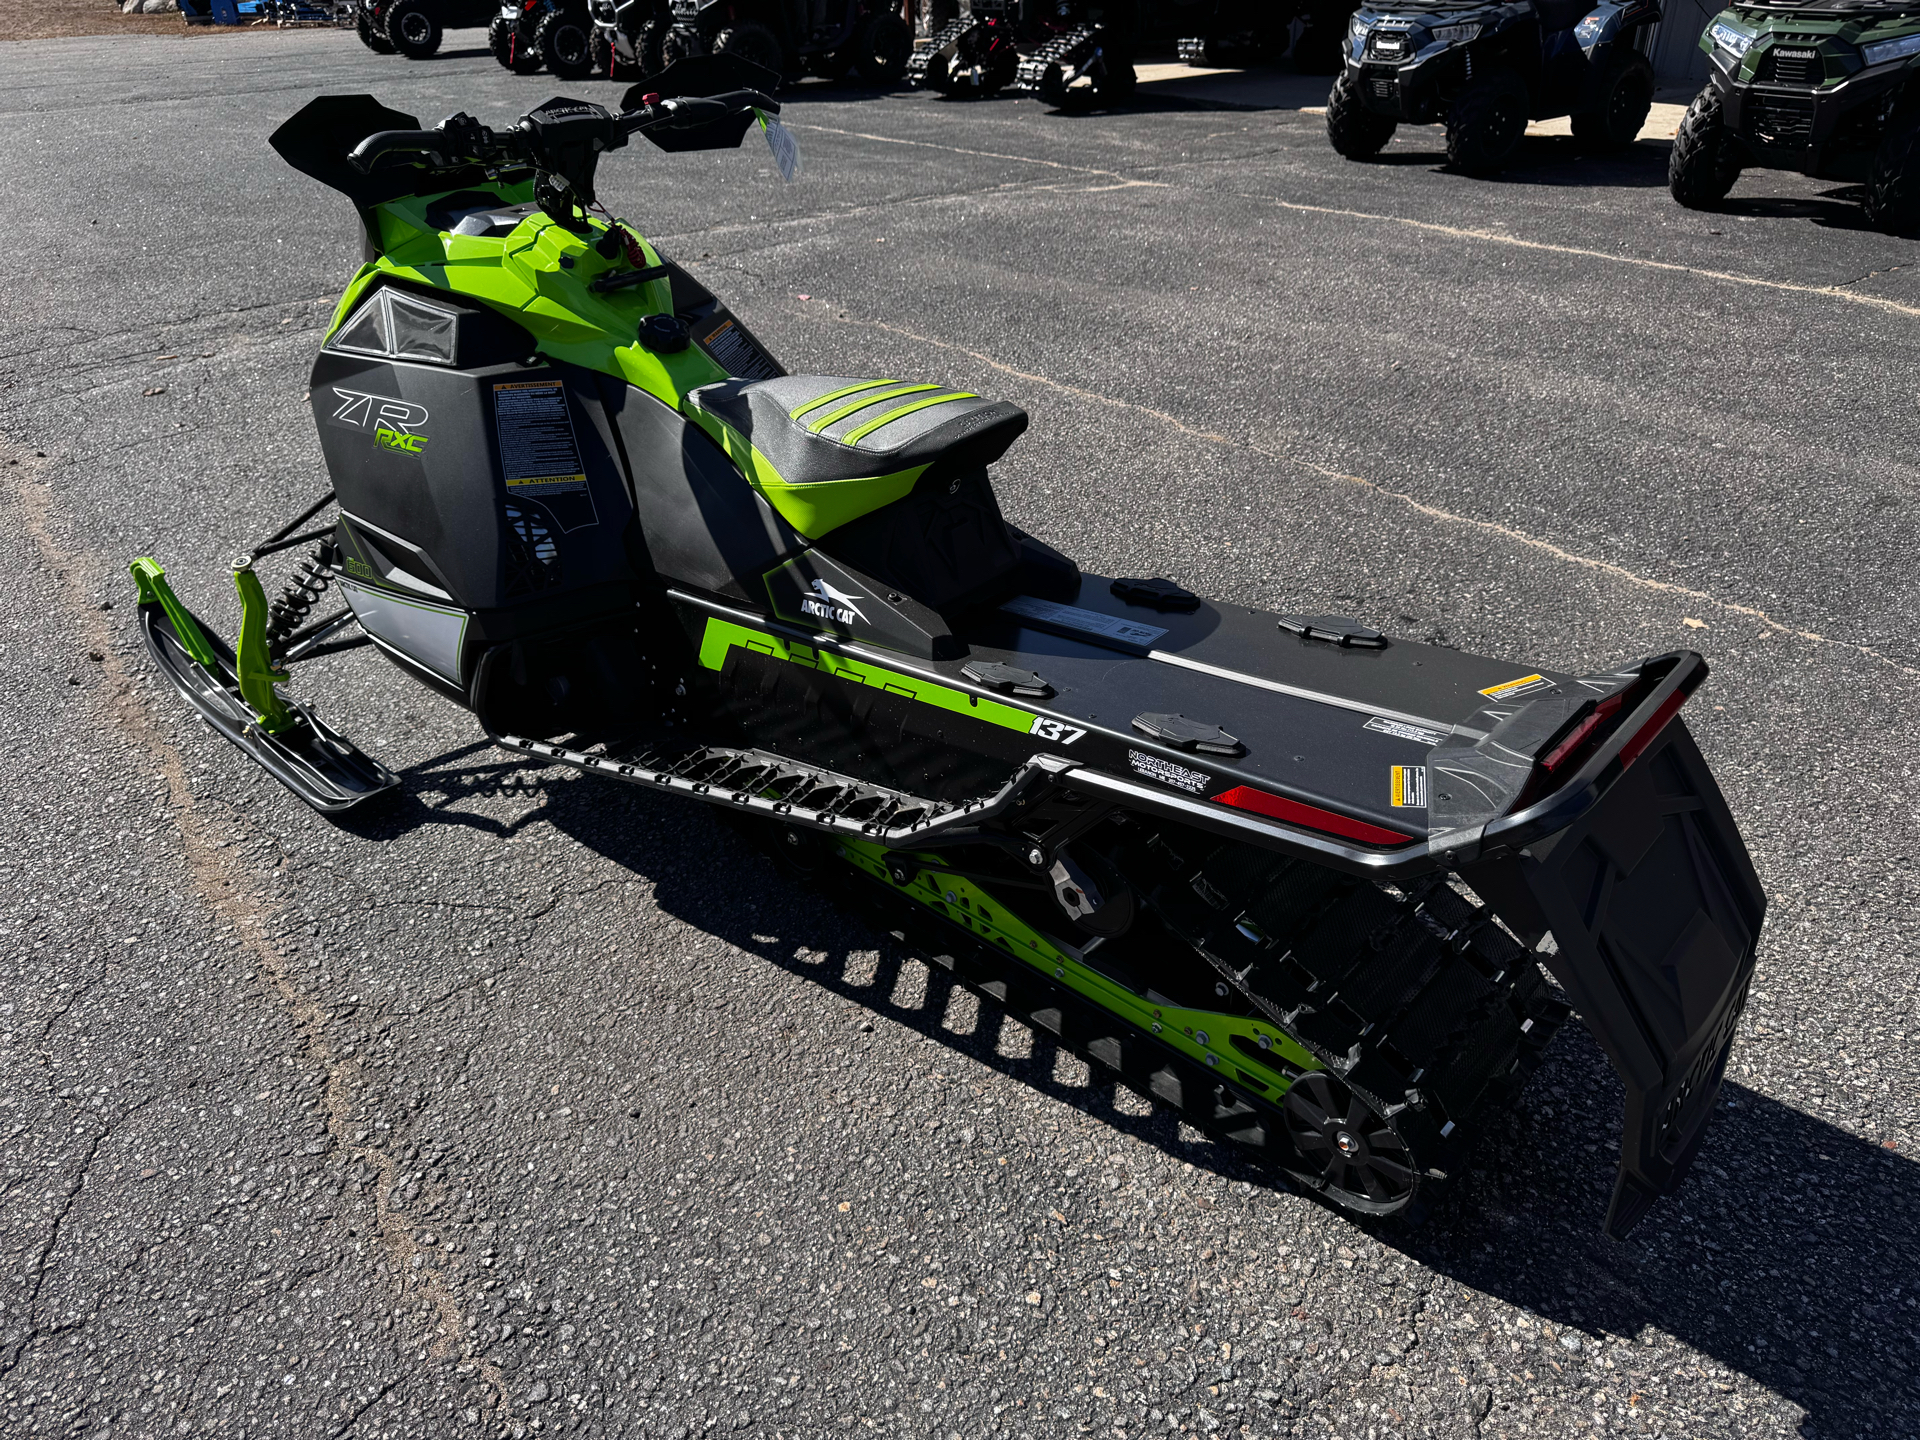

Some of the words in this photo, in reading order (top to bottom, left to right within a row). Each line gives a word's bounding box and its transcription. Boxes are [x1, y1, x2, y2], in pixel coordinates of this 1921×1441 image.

[1773, 48, 1816, 59] Kawasaki
[510, 381, 556, 389] AVERTISSEMENT
[332, 387, 429, 434] ZR
[373, 428, 429, 456] RXC
[529, 476, 576, 484] ATTENTION
[346, 559, 373, 580] 600
[801, 599, 835, 620] ARCTIC
[836, 608, 855, 625] CAT
[1029, 716, 1087, 745] 137
[1128, 749, 1211, 785] NORTHEAST
[1131, 759, 1204, 789] MOTORSPORTS
